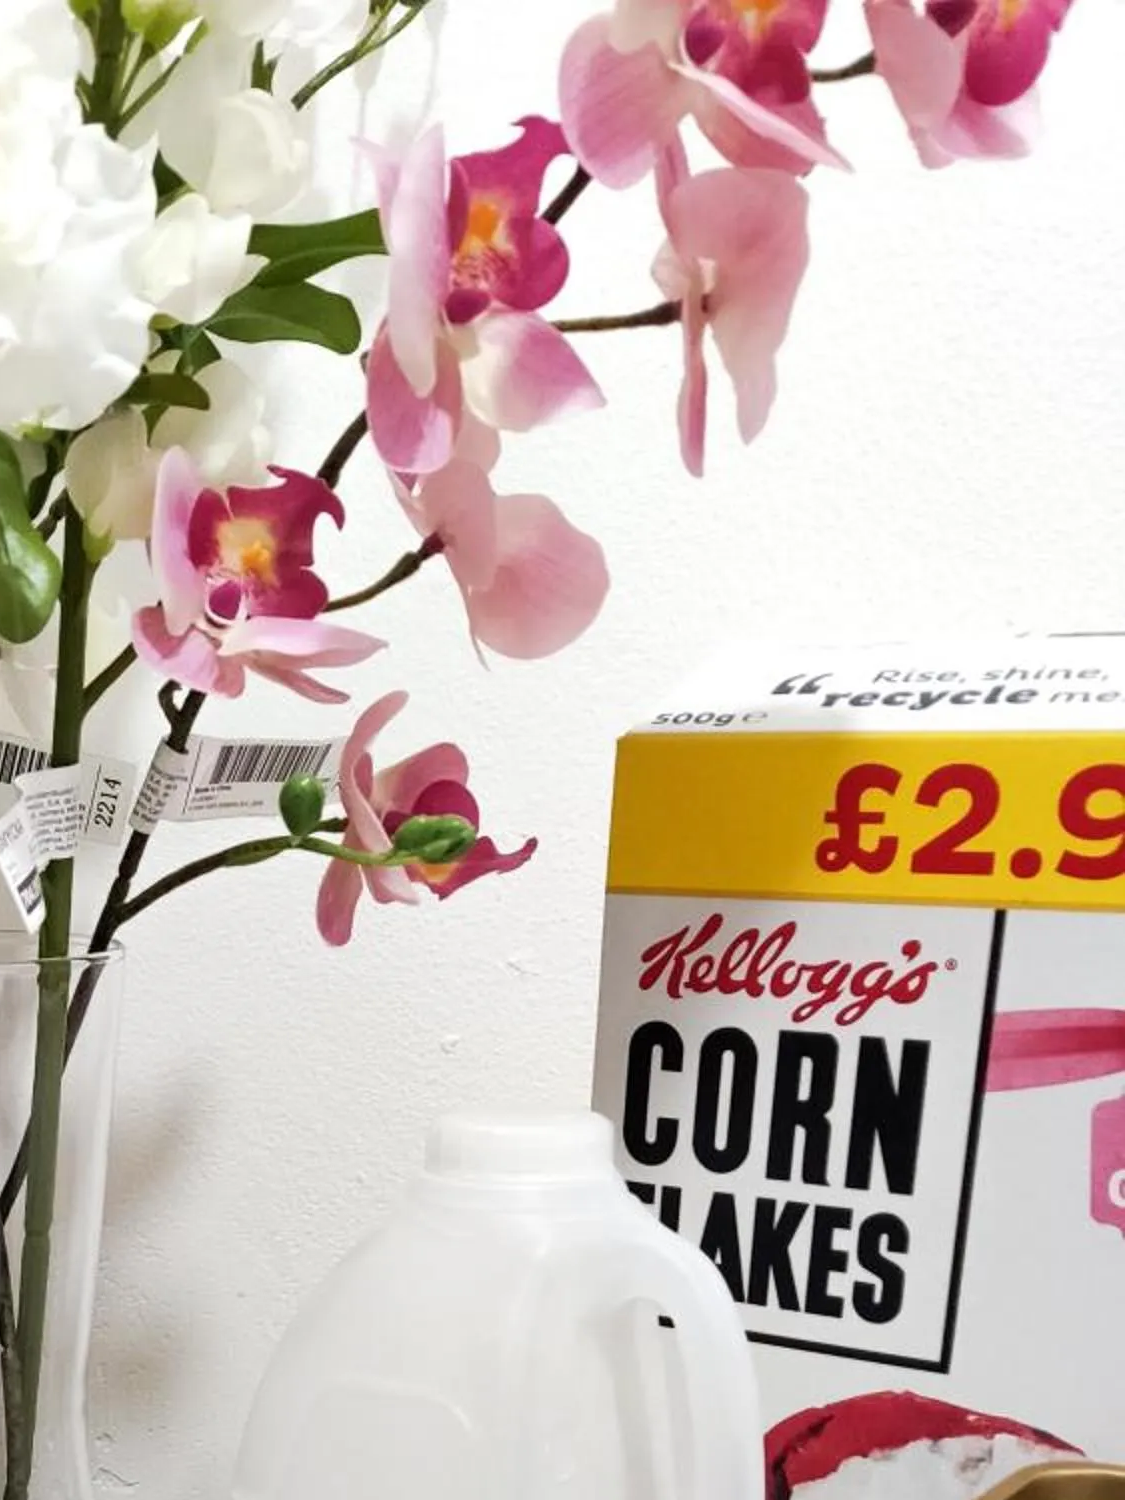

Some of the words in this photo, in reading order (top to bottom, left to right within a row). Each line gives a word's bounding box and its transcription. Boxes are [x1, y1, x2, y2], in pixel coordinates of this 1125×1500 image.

[821, 684, 1039, 711] recycle
[872, 668, 966, 686] Rise,
[981, 665, 1110, 683] shine,
[651, 711, 736, 726] 500g
[93, 777, 123, 829] 2214
[639, 913, 938, 1026] Kellogg's
[622, 1020, 932, 1195] CORN
[626, 1180, 911, 1325] AKES
